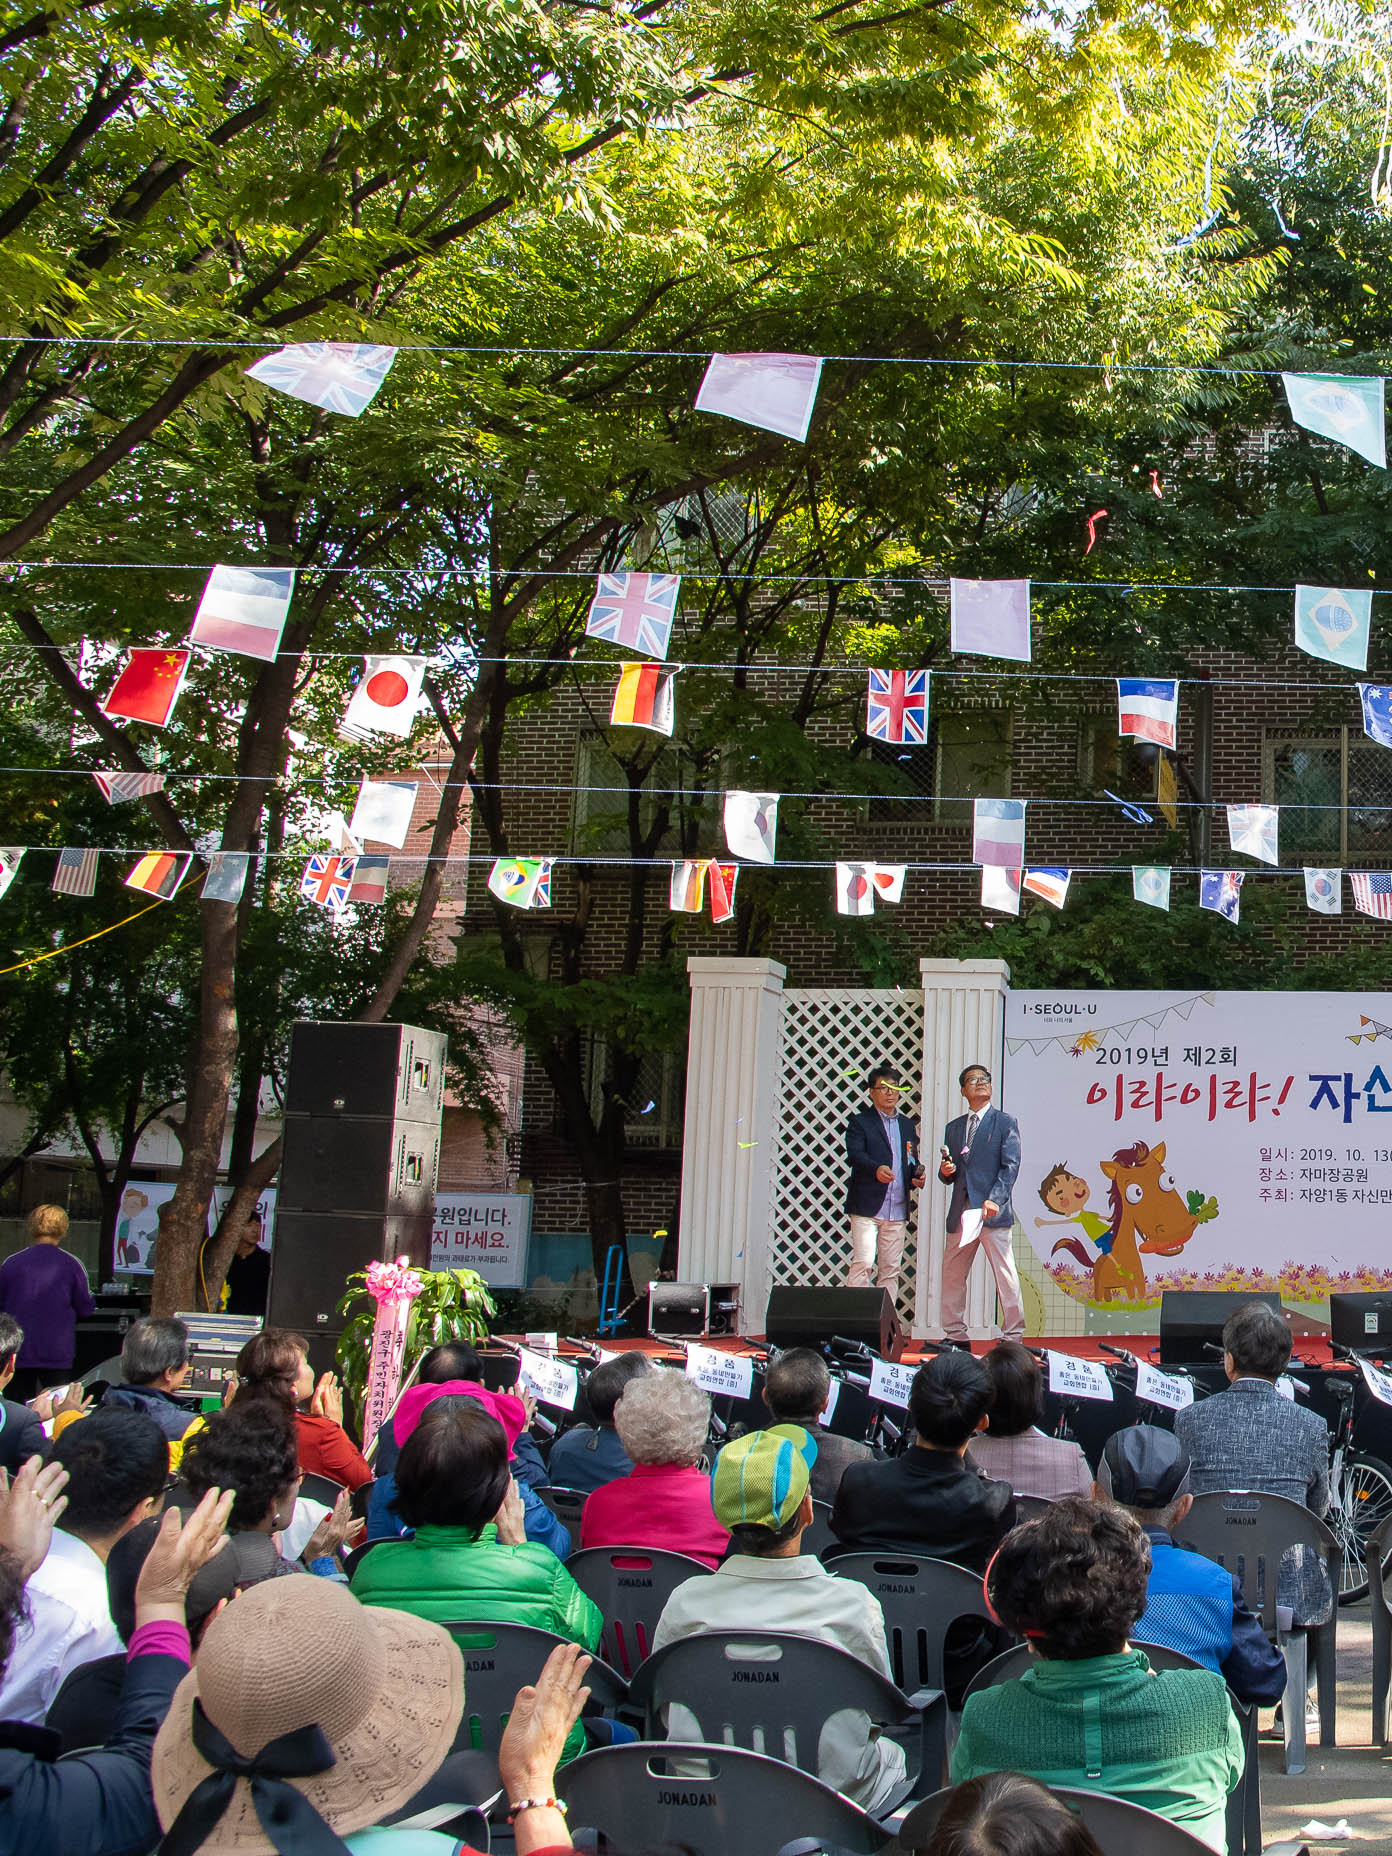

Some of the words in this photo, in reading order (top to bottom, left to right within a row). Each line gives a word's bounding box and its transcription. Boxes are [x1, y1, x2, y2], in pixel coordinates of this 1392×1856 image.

[1096, 1046, 1169, 1067] 2019년
[1183, 1046, 1238, 1067] 제2회
[1086, 1072, 1295, 1123] 이랴이랴!
[1300, 1148, 1337, 1162] 2019.
[1345, 1148, 1365, 1162] 10.
[1300, 1168, 1369, 1183] 자마장공원
[1300, 1189, 1348, 1204] 자양1동
[455, 1230, 510, 1250] 마세요.
[617, 1576, 653, 1588] JONADAN
[877, 1583, 915, 1594] JONADAN
[731, 1671, 780, 1684] JONADAN
[657, 1791, 717, 1806] JONADAN
